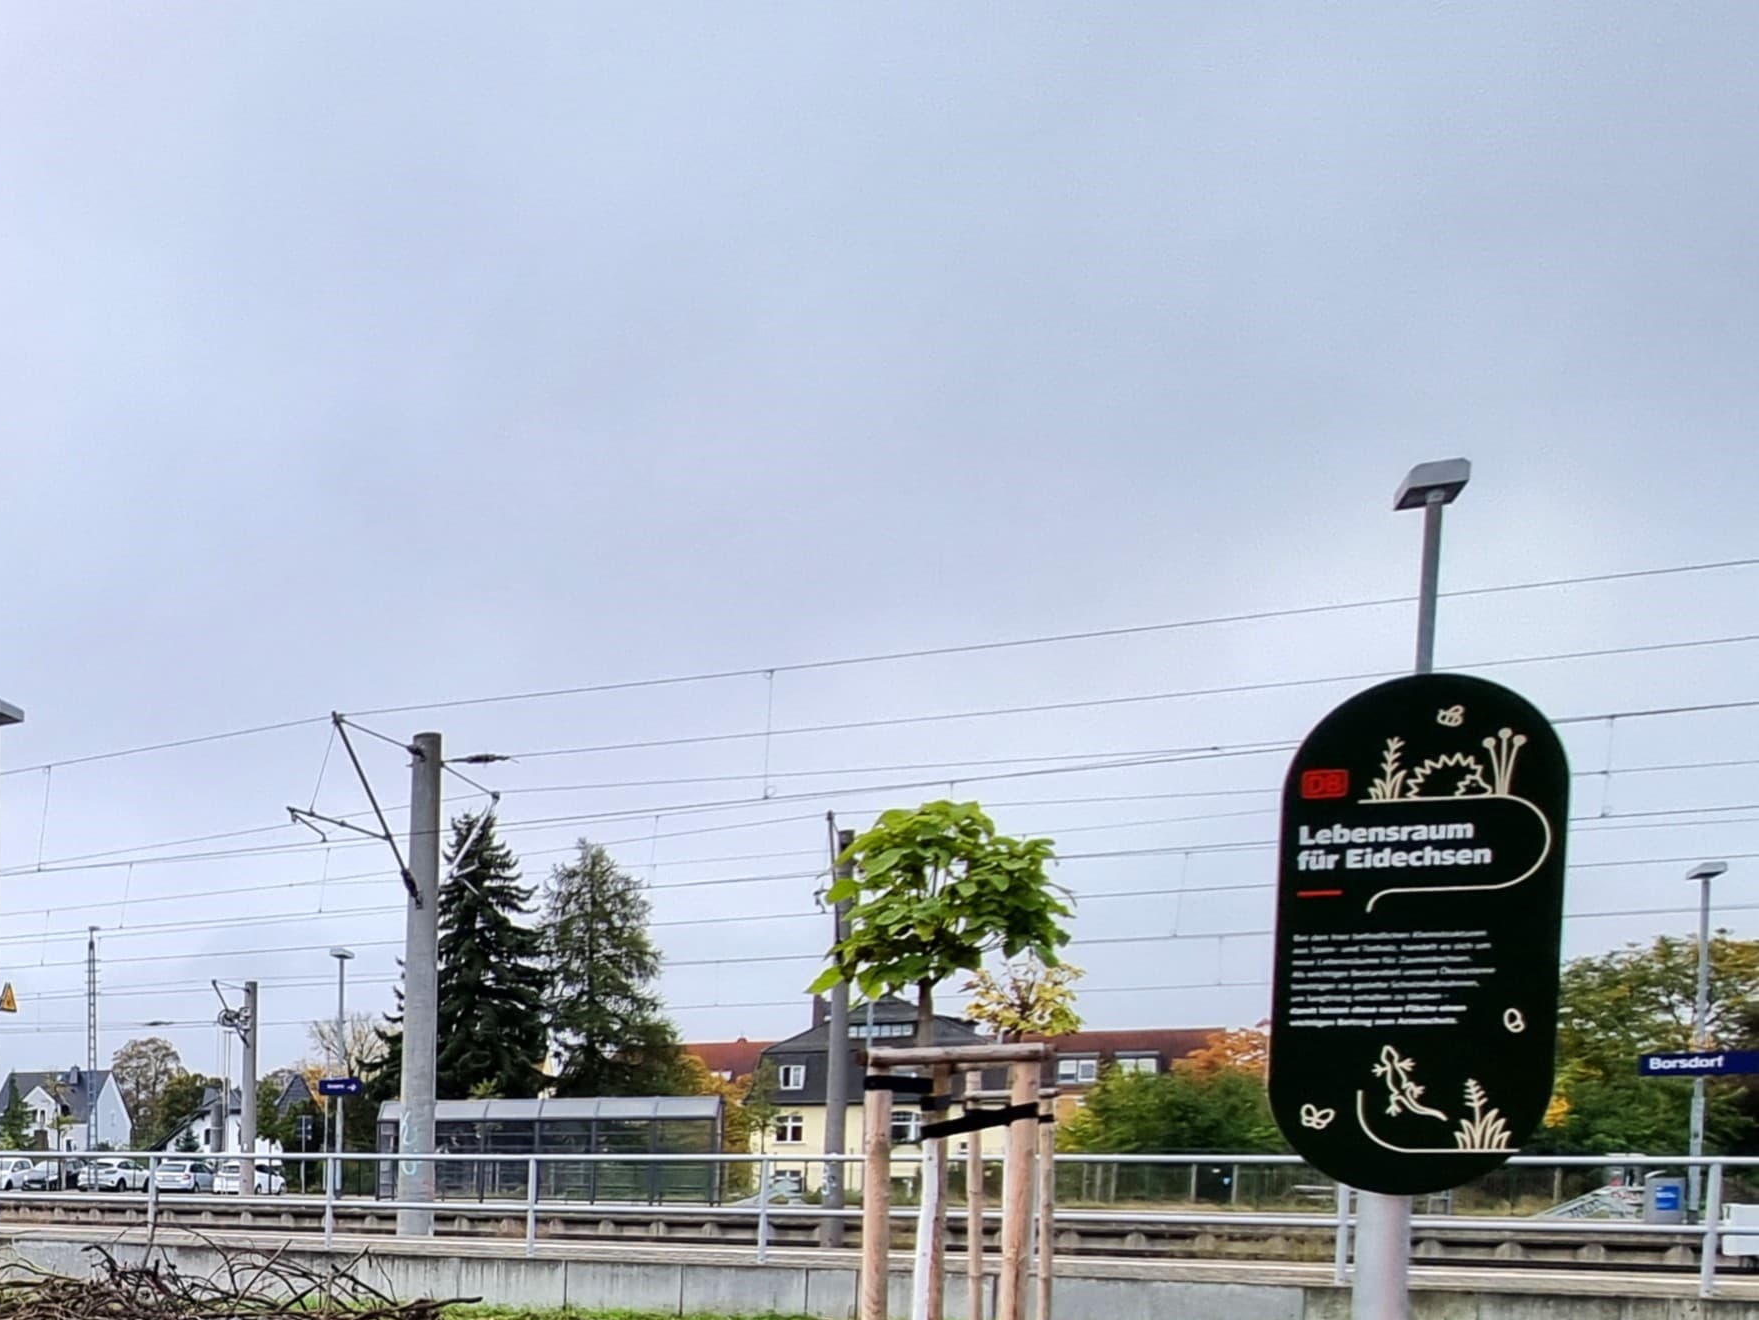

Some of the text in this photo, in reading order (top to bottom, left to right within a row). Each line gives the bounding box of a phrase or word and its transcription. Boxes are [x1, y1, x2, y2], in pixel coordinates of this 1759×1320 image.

[1306, 773, 1343, 796] DB
[1298, 823, 1474, 846] Lebensraum
[1297, 846, 1492, 870] für Eidechsen
[1649, 1055, 1724, 1070] Borsdorf
